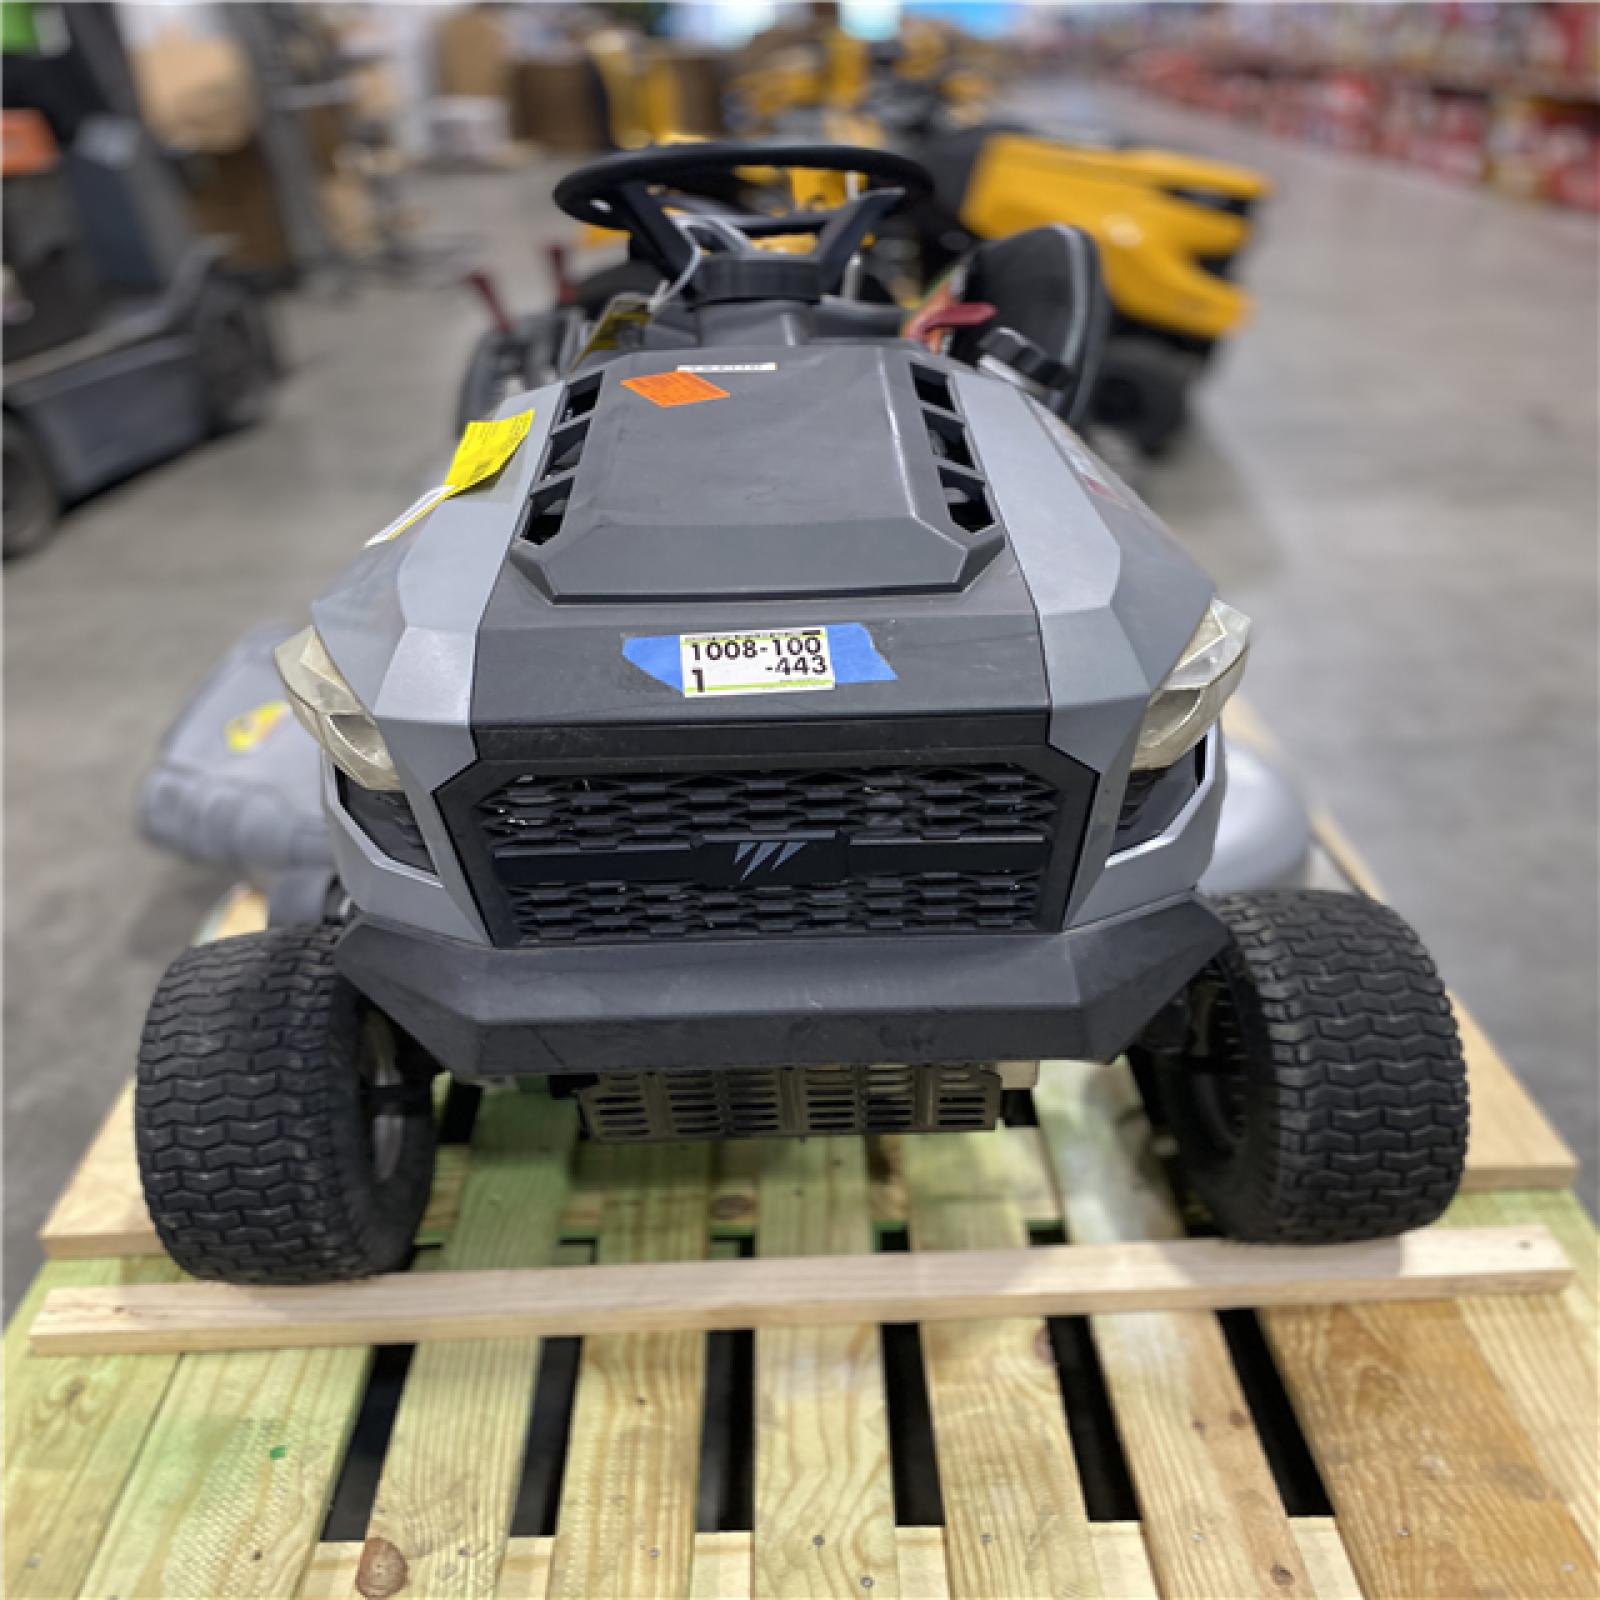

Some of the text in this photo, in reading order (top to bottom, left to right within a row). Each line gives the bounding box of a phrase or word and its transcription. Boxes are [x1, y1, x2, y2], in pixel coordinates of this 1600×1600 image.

[691, 637, 822, 661] 1008-100
[765, 654, 827, 676] -443
[692, 669, 705, 693] 1
